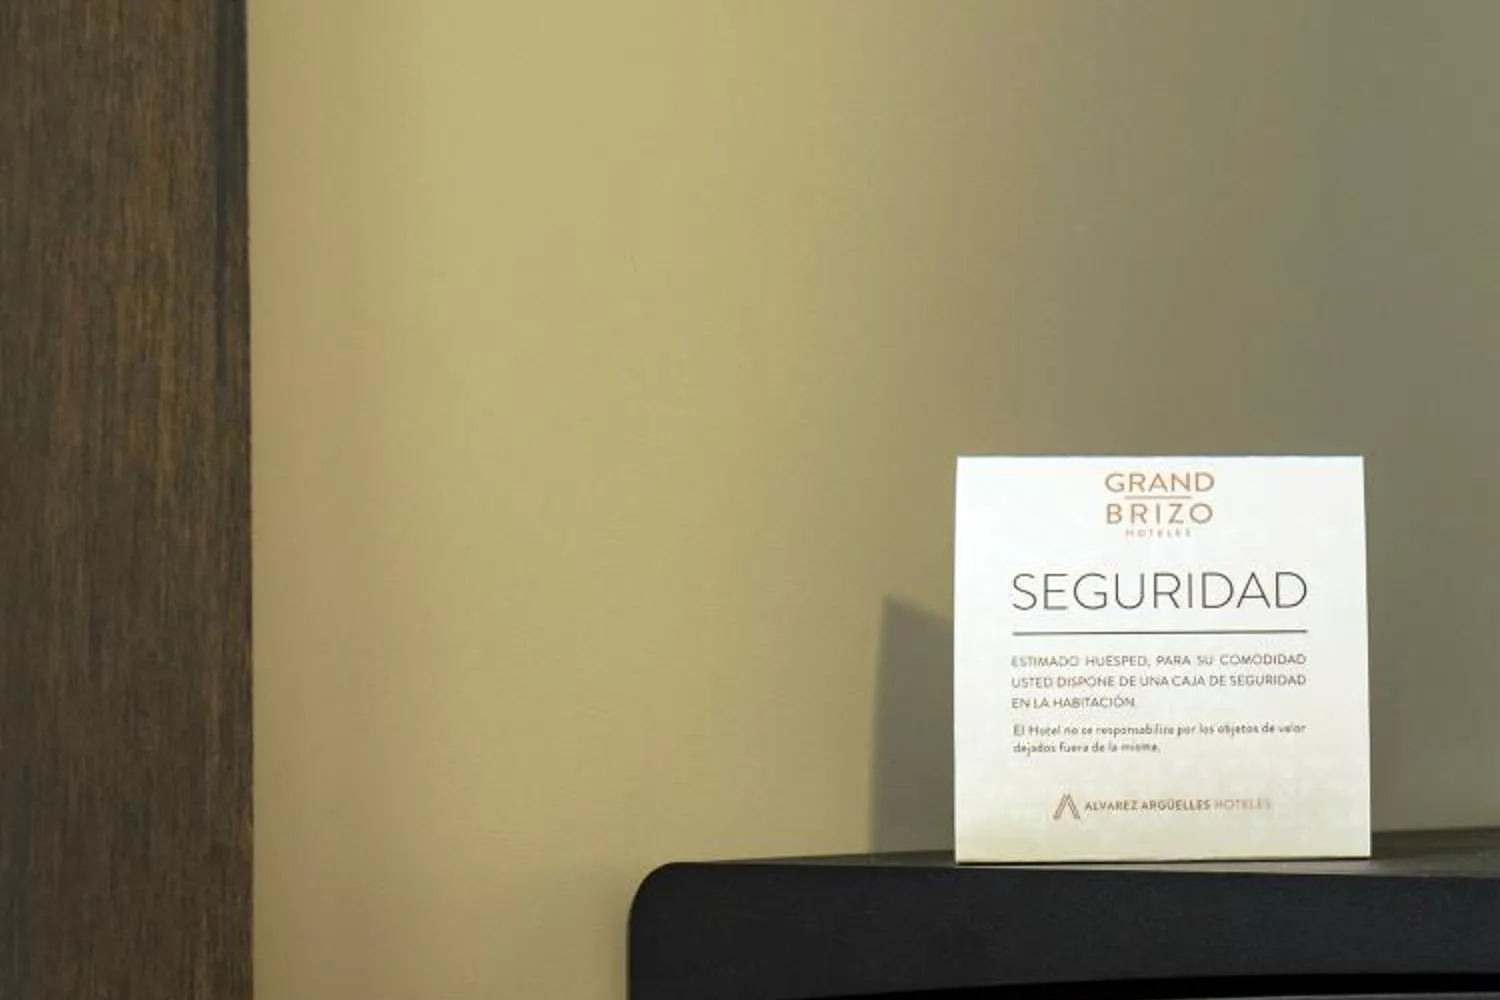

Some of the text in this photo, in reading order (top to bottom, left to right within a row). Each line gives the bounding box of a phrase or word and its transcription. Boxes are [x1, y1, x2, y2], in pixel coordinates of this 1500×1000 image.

[1104, 472, 1215, 493] GRAND
[1106, 502, 1213, 524] BRIZO
[1125, 528, 1191, 538] HOTELES
[1012, 571, 1308, 611] SEGURIDAD
[1011, 655, 1079, 667] ESTIMADO
[1156, 655, 1191, 665] PARA
[1197, 655, 1213, 665] SU
[1219, 653, 1307, 665] COMODIDAD
[1011, 674, 1307, 688] USTED DISPONE DE UNA CAJA DE SEGURIDAD
[1011, 697, 1030, 709] EN
[1033, 697, 1050, 708] LA
[1013, 724, 1025, 736] El
[1028, 724, 1060, 736] Hotel
[1063, 727, 1078, 735] no
[1081, 727, 1093, 735] se
[1177, 727, 1196, 736] por
[1200, 724, 1215, 735] los
[1217, 723, 1259, 738] objetos
[1261, 722, 1275, 734] de
[1279, 723, 1306, 734] valor
[1013, 741, 1056, 757] dejados
[1059, 741, 1089, 753] fuera
[1091, 741, 1105, 753] de
[1107, 740, 1118, 751] la
[1085, 797, 1271, 811] ALVAREZ ARGÜELLES HOTELES
